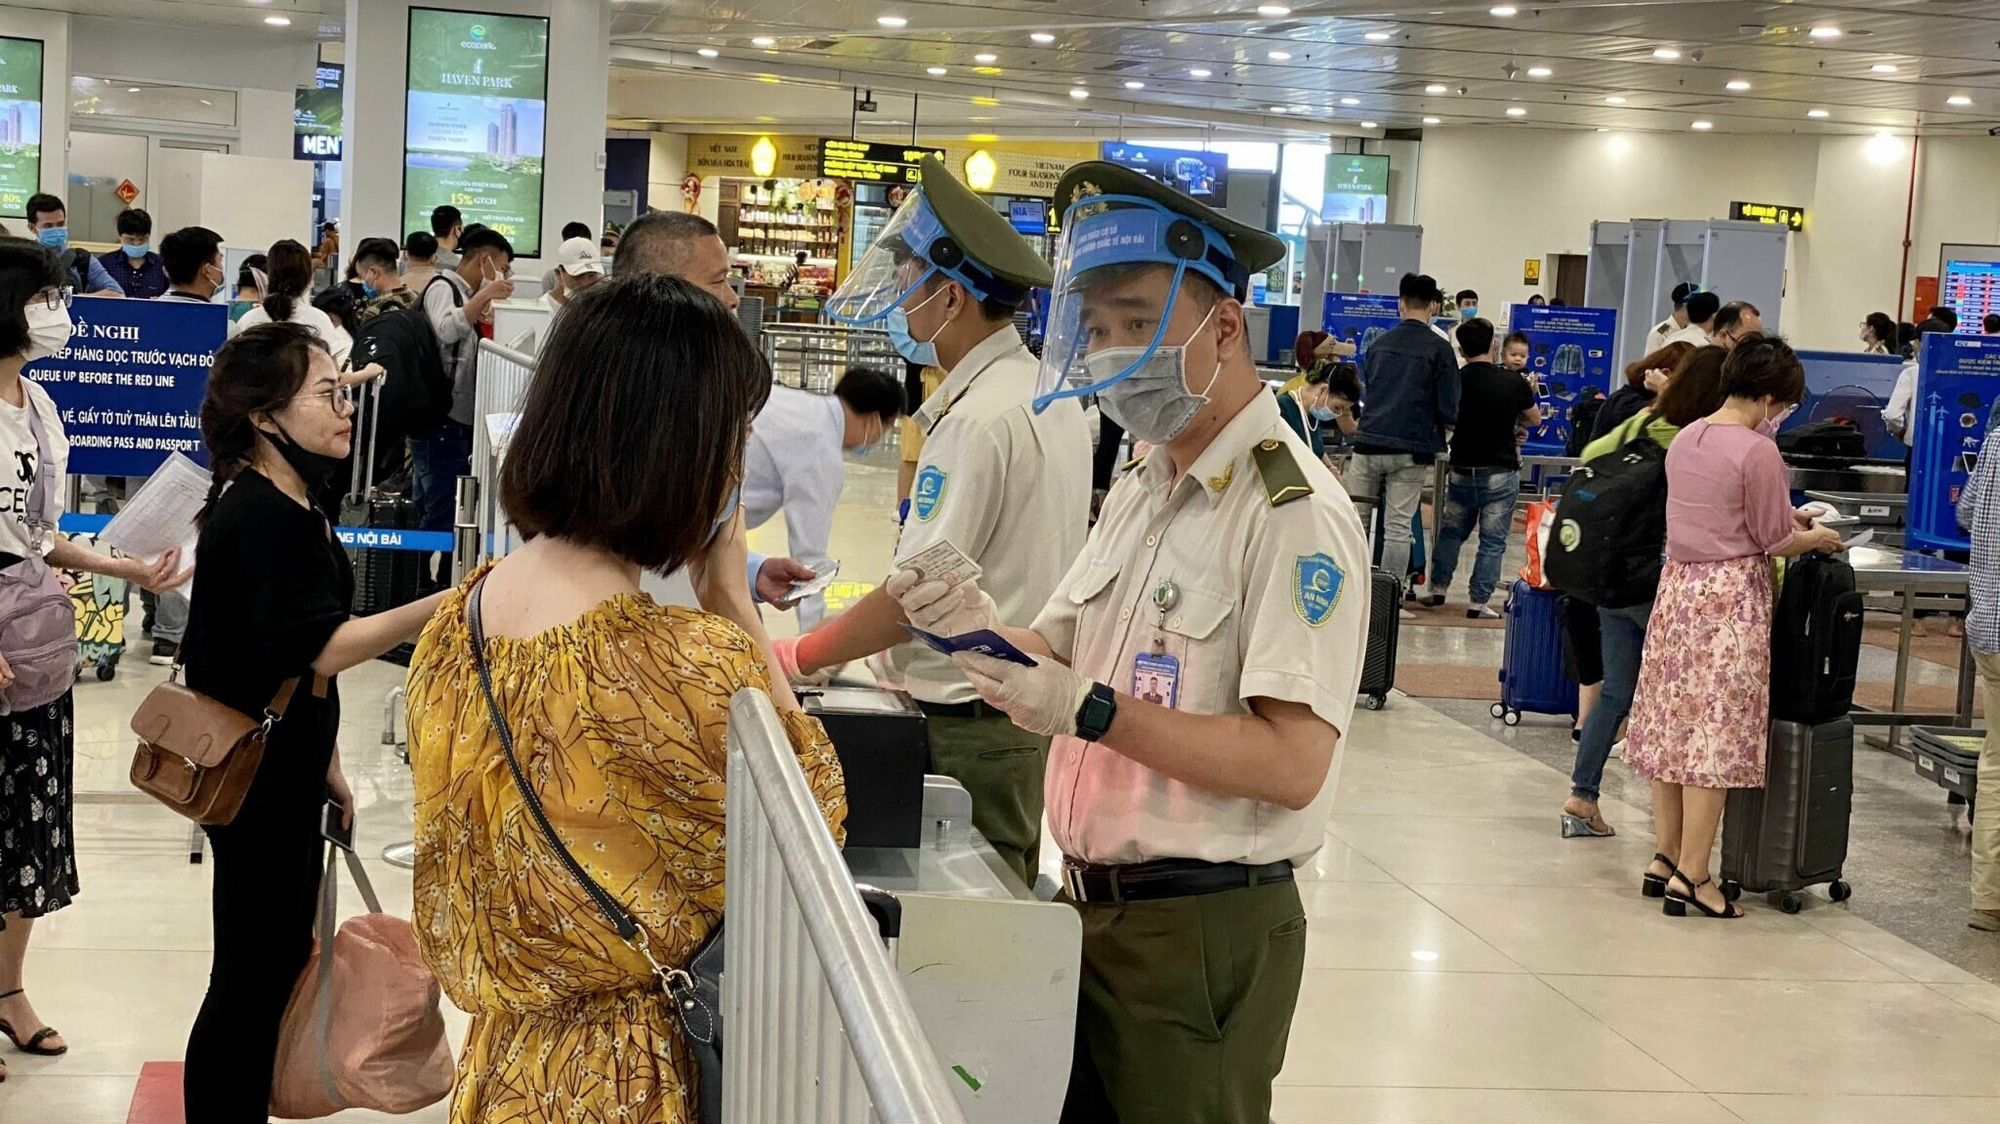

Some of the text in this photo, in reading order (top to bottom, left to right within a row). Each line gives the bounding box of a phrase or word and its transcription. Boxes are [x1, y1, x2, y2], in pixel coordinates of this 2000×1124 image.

[442, 73, 513, 88] HAVEN PARK
[1036, 162, 1064, 170] VIETNAM
[450, 193, 473, 206] 15%
[1012, 207, 1028, 216] NIA
[93, 325, 140, 342] NGHỊ
[74, 345, 103, 362] HÀNG
[106, 350, 129, 366] DỌC
[132, 348, 166, 365] TRƯỚC
[168, 353, 197, 368] VẠCH
[199, 350, 214, 367] ĐỎ
[29, 368, 174, 387] QUEUE UP BEFORE THE RED LINE
[62, 407, 76, 425] VÉ,
[78, 406, 99, 424] GIẤY
[101, 409, 114, 425] TỜ
[134, 411, 158, 427] THÂN
[160, 412, 177, 428] LÊN
[70, 435, 112, 448] BOARDING
[114, 436, 134, 449] PASS
[136, 438, 154, 449] AND
[357, 531, 378, 546] NỘI
[380, 532, 402, 545] BÀI
